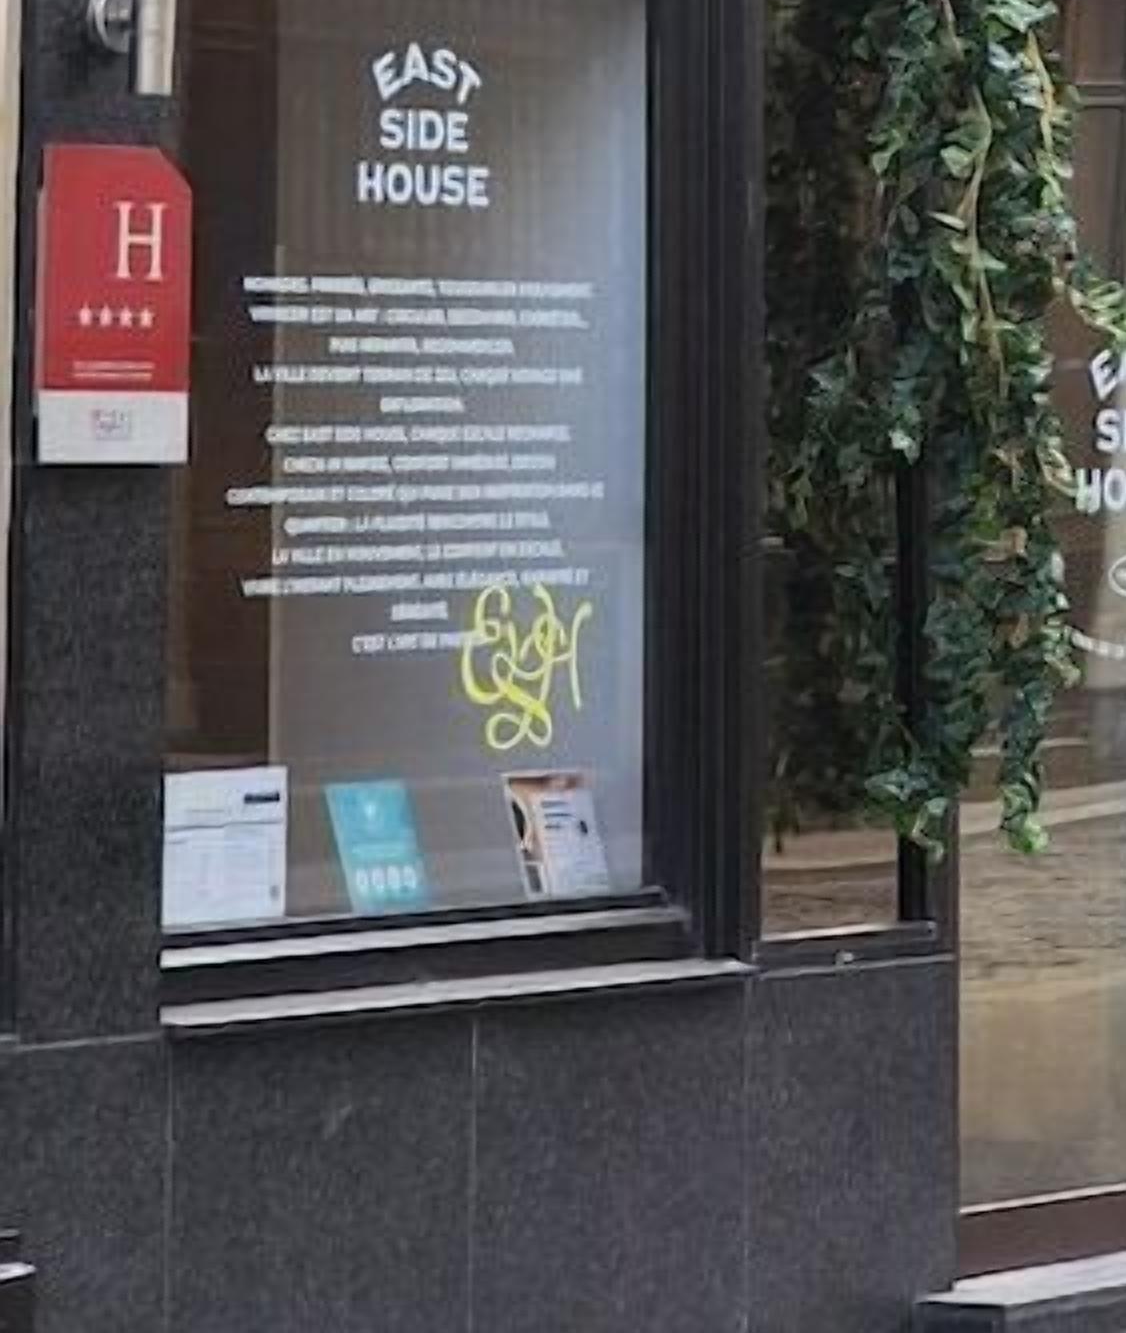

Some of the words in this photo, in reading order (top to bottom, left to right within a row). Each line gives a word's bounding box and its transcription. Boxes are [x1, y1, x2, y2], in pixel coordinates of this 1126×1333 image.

[372, 42, 482, 106] EAST
[379, 108, 469, 154] SIDE
[357, 160, 490, 209] HOUSE
[112, 199, 167, 282] H
